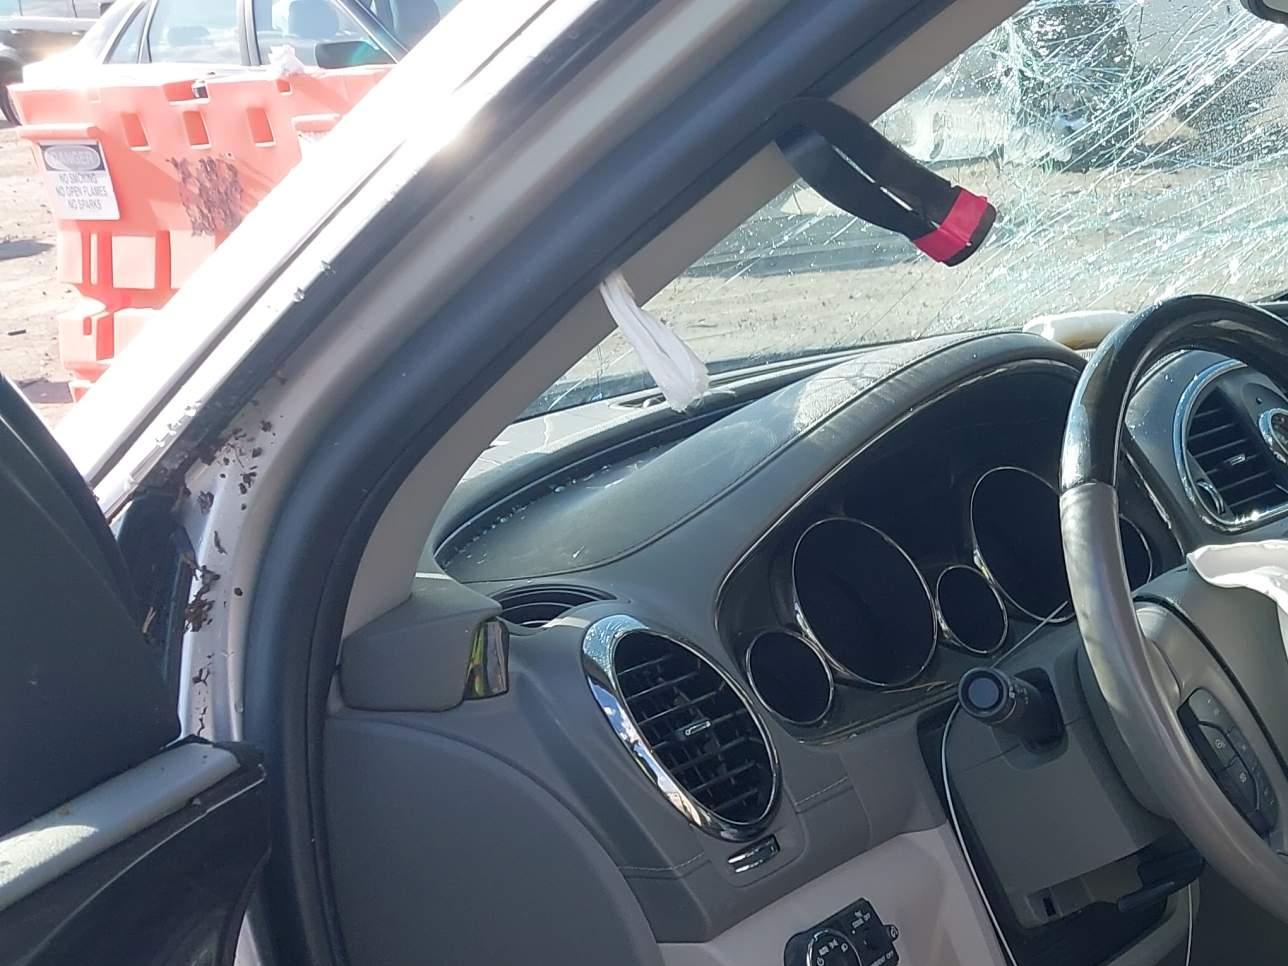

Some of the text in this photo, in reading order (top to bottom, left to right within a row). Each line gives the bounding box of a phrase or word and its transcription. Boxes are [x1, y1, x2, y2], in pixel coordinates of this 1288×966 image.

[58, 173, 98, 184] NO SMOKING
[56, 186, 108, 197] NO OPEN FLAMES
[67, 199, 102, 210] NO SPARKS
